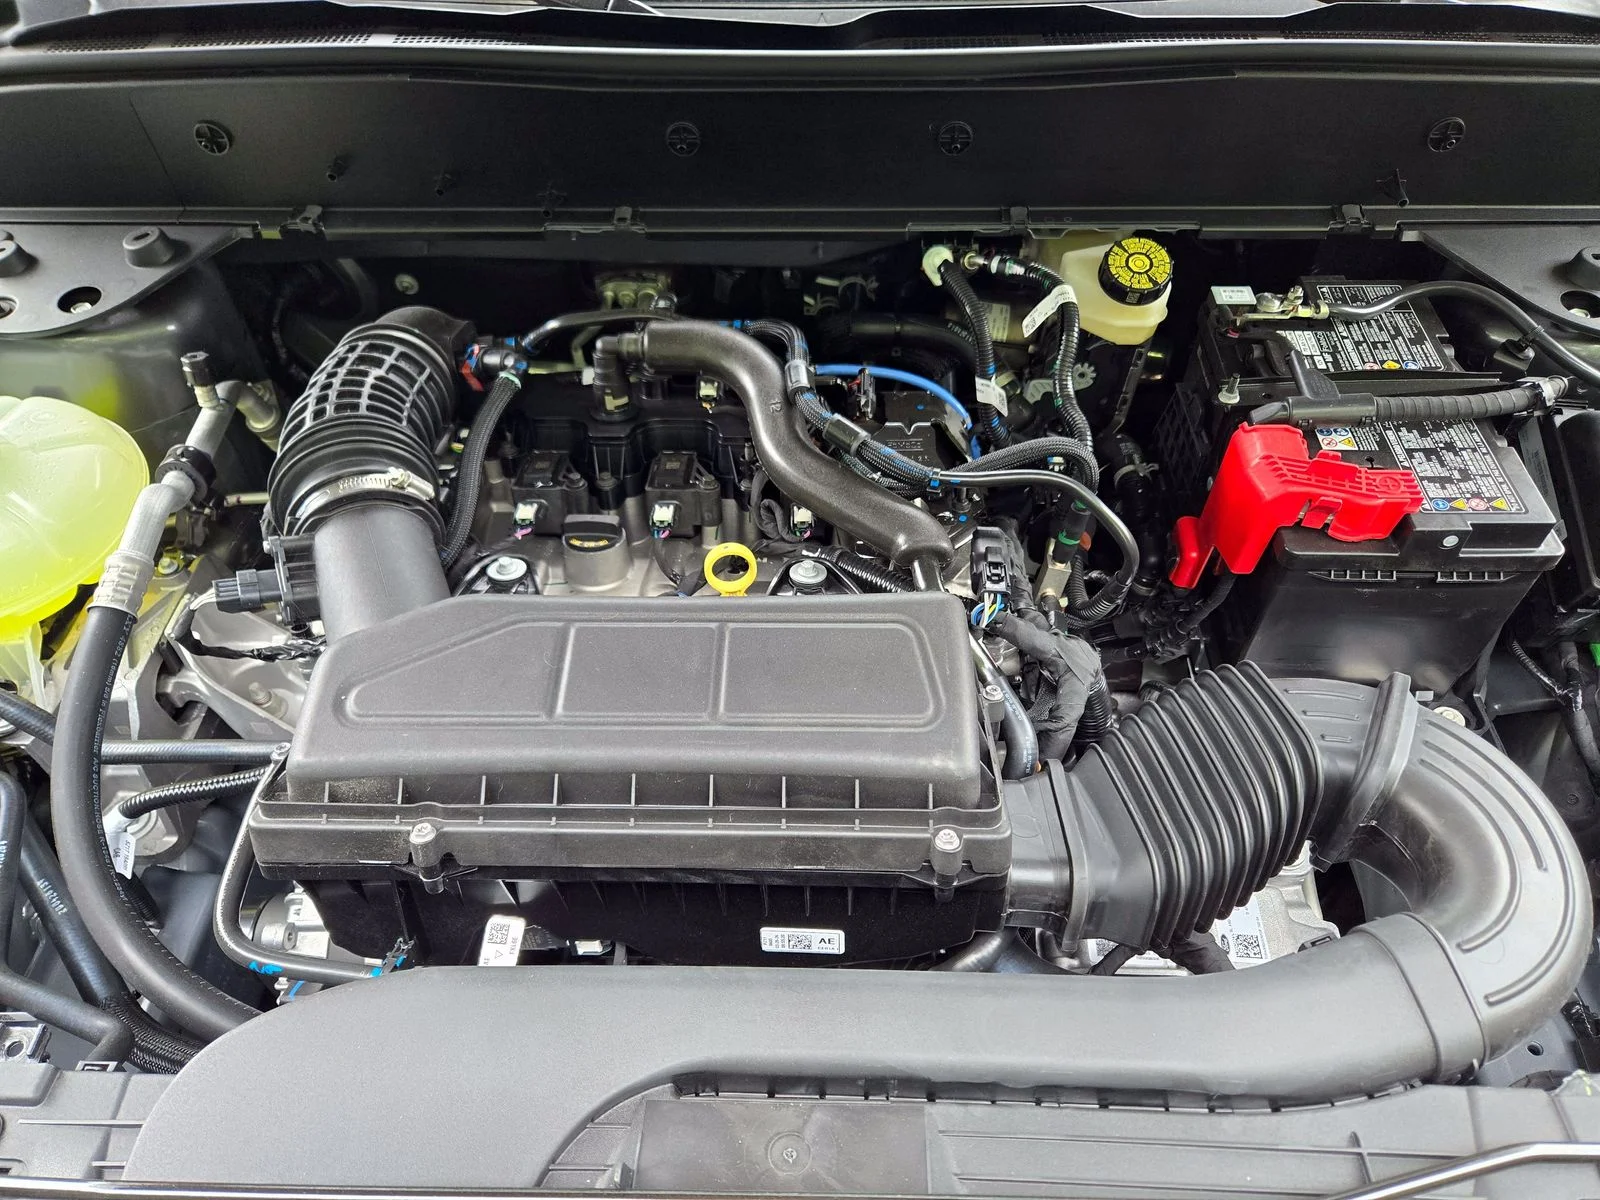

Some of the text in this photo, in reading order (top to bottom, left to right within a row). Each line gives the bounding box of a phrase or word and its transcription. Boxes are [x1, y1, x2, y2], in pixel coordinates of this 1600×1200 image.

[92, 773, 101, 811] SUCTION
[94, 812, 105, 834] HOSE
[818, 937, 836, 945] AE
